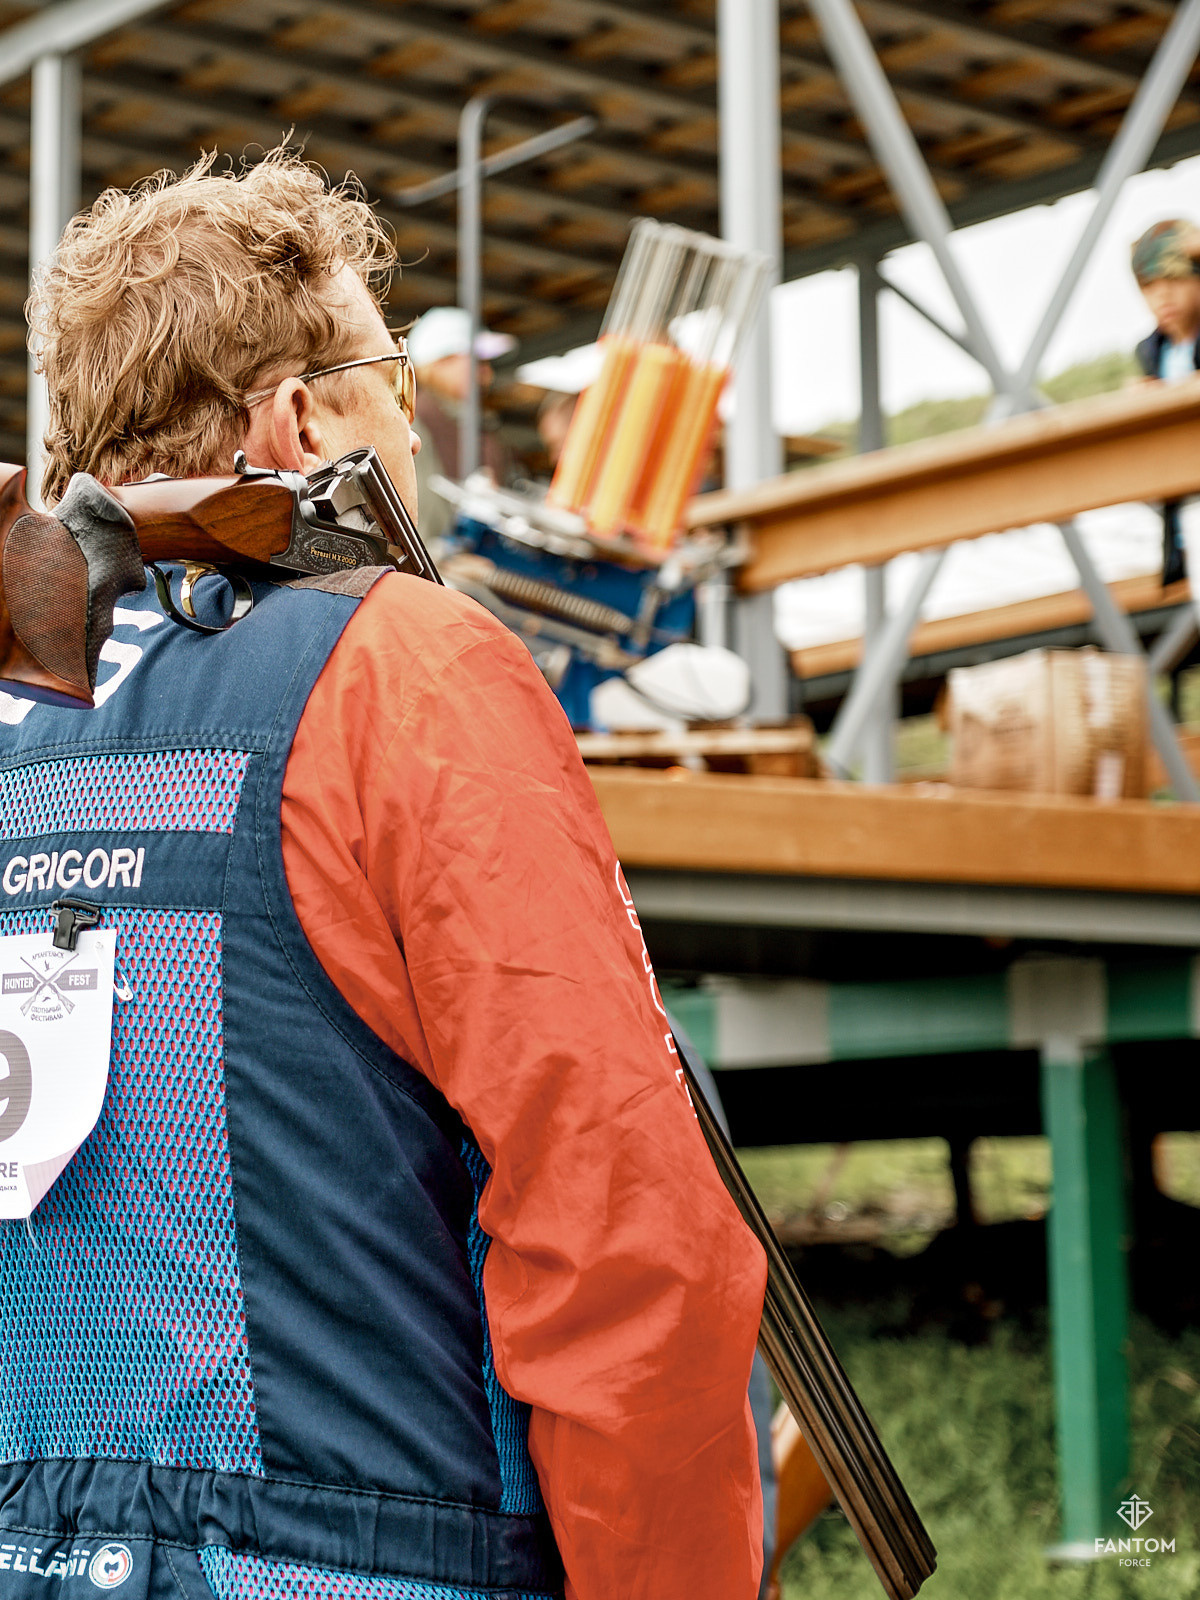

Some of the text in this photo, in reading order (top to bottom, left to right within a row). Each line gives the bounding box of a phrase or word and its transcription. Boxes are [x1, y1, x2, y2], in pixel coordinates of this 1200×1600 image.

[2, 847, 145, 896] GRIGORI
[4, 974, 91, 990] HUNTER FEST
